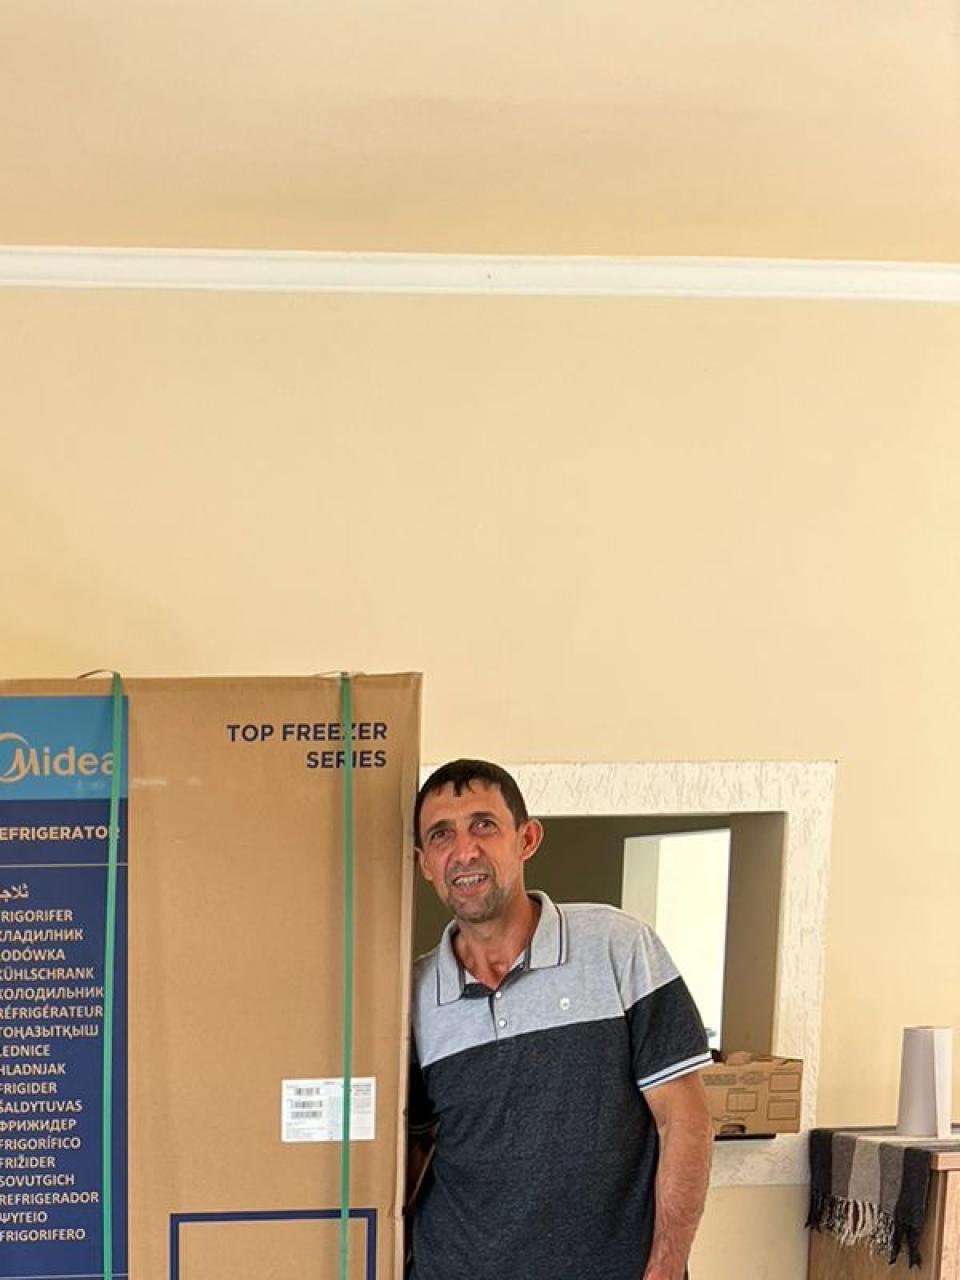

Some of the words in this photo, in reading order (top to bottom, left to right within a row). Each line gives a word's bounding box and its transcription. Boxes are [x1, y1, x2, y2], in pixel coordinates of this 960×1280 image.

[227, 724, 275, 742] TOP
[282, 723, 388, 742] FREEER
[0, 1228, 87, 1243] FRIGORIFERO
